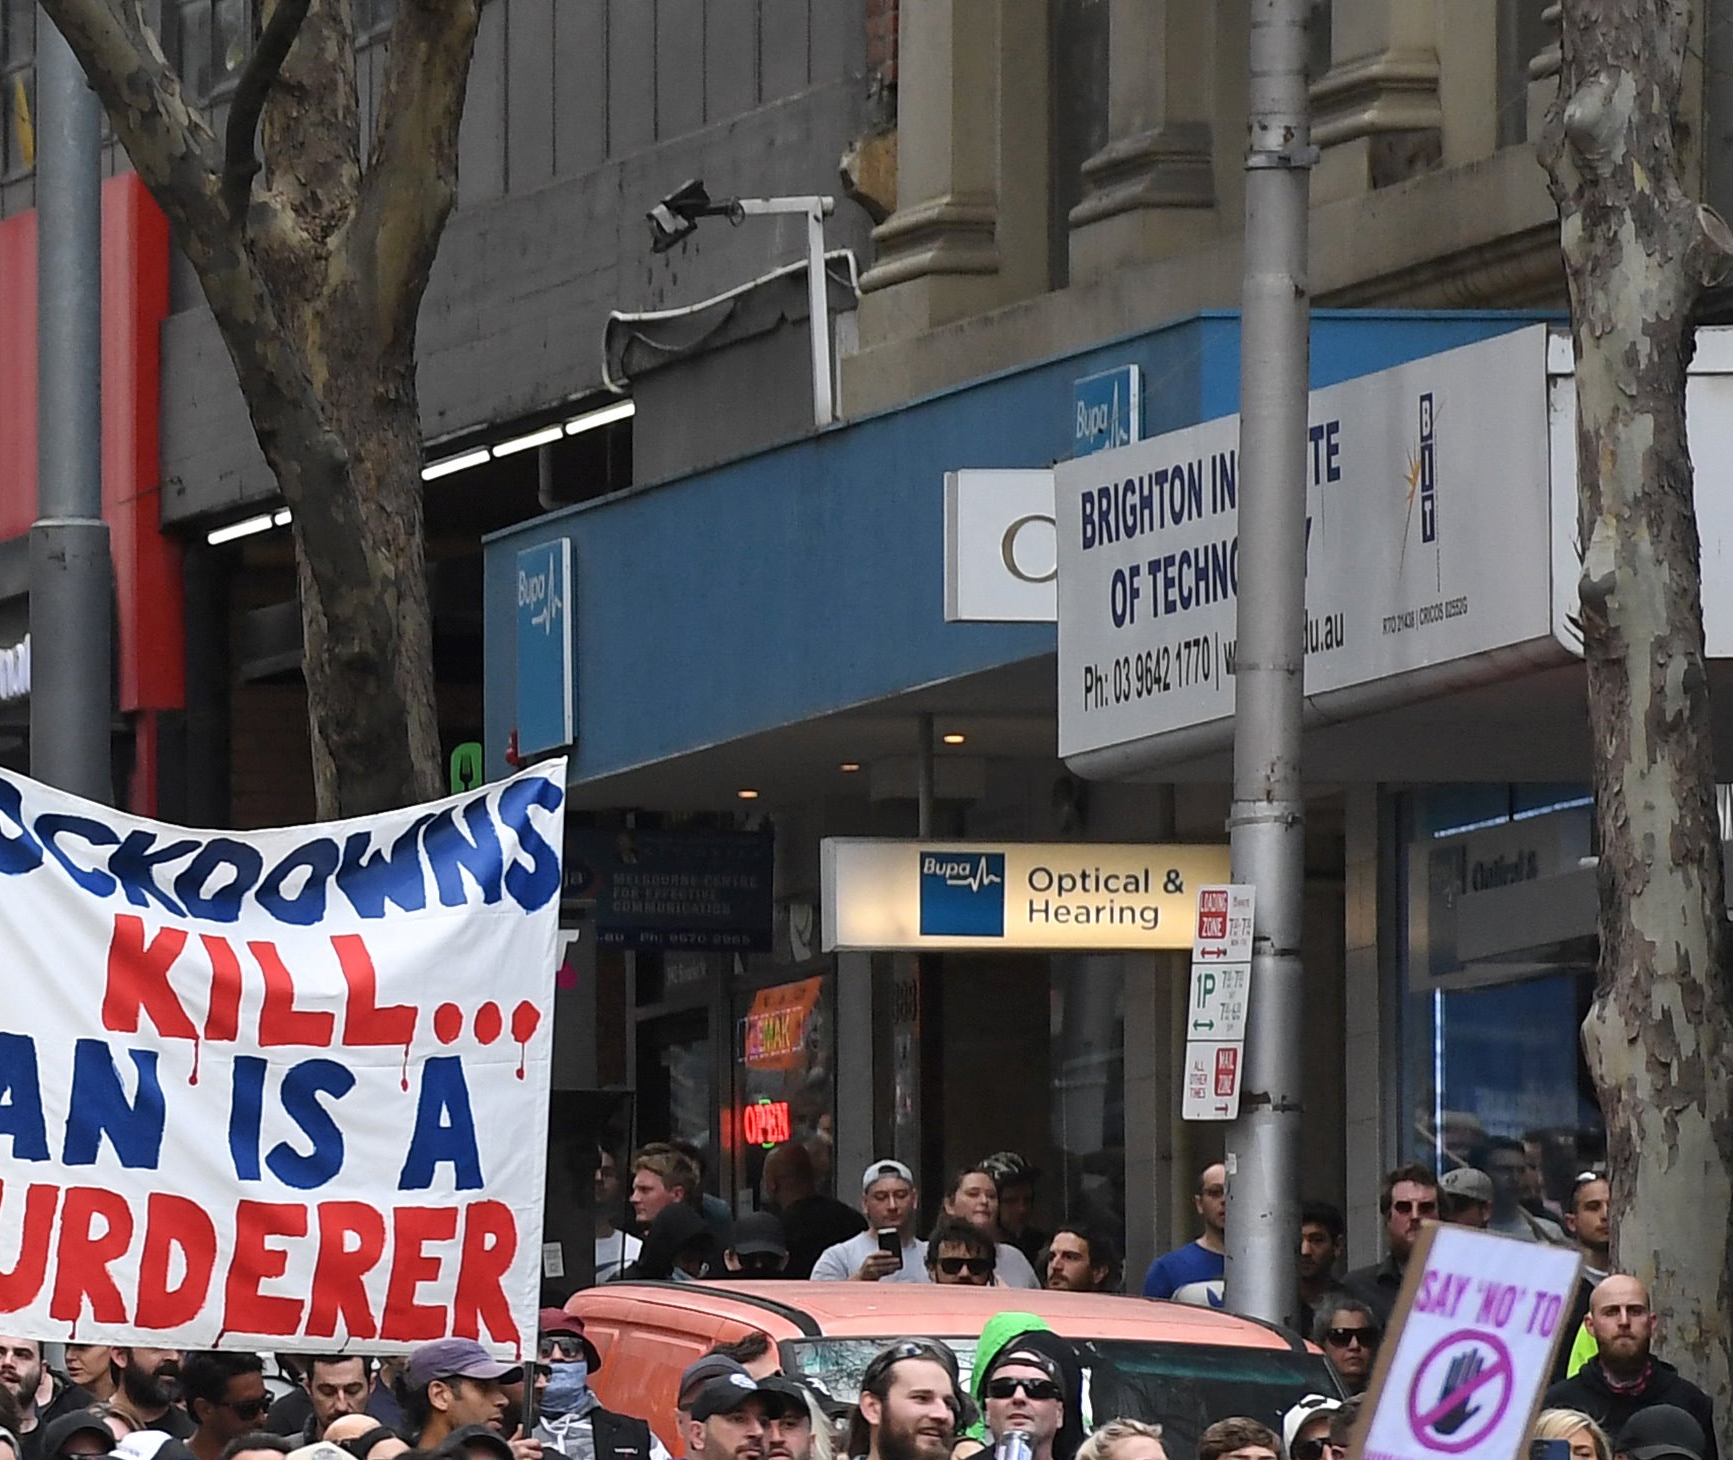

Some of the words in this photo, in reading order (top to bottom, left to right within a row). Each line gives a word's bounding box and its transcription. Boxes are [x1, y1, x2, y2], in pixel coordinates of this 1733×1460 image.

[1076, 401, 1107, 443] Bupa
[1081, 457, 1203, 551] BRIGHTON
[519, 570, 544, 609] Bupa
[1111, 563, 1141, 628] OF
[1084, 664, 1109, 711] Ph:
[1112, 656, 1132, 704] 03
[1135, 647, 1171, 699] 9642
[1176, 636, 1211, 691] 1770
[923, 857, 971, 879] Bupa
[1028, 866, 1150, 894] Optical
[1163, 868, 1184, 894] &
[1029, 898, 1160, 930] Hearing
[1200, 892, 1227, 912] LOADING
[1201, 917, 1223, 937] ZONE
[1196, 972, 1216, 1009] 1P
[1193, 1060, 1204, 1072] ALL
[228, 1055, 356, 1190] IS
[398, 1055, 484, 1190] A
[744, 1102, 790, 1144] OPEN
[1415, 1269, 1471, 1319] SAY
[1526, 1289, 1563, 1338] TO
